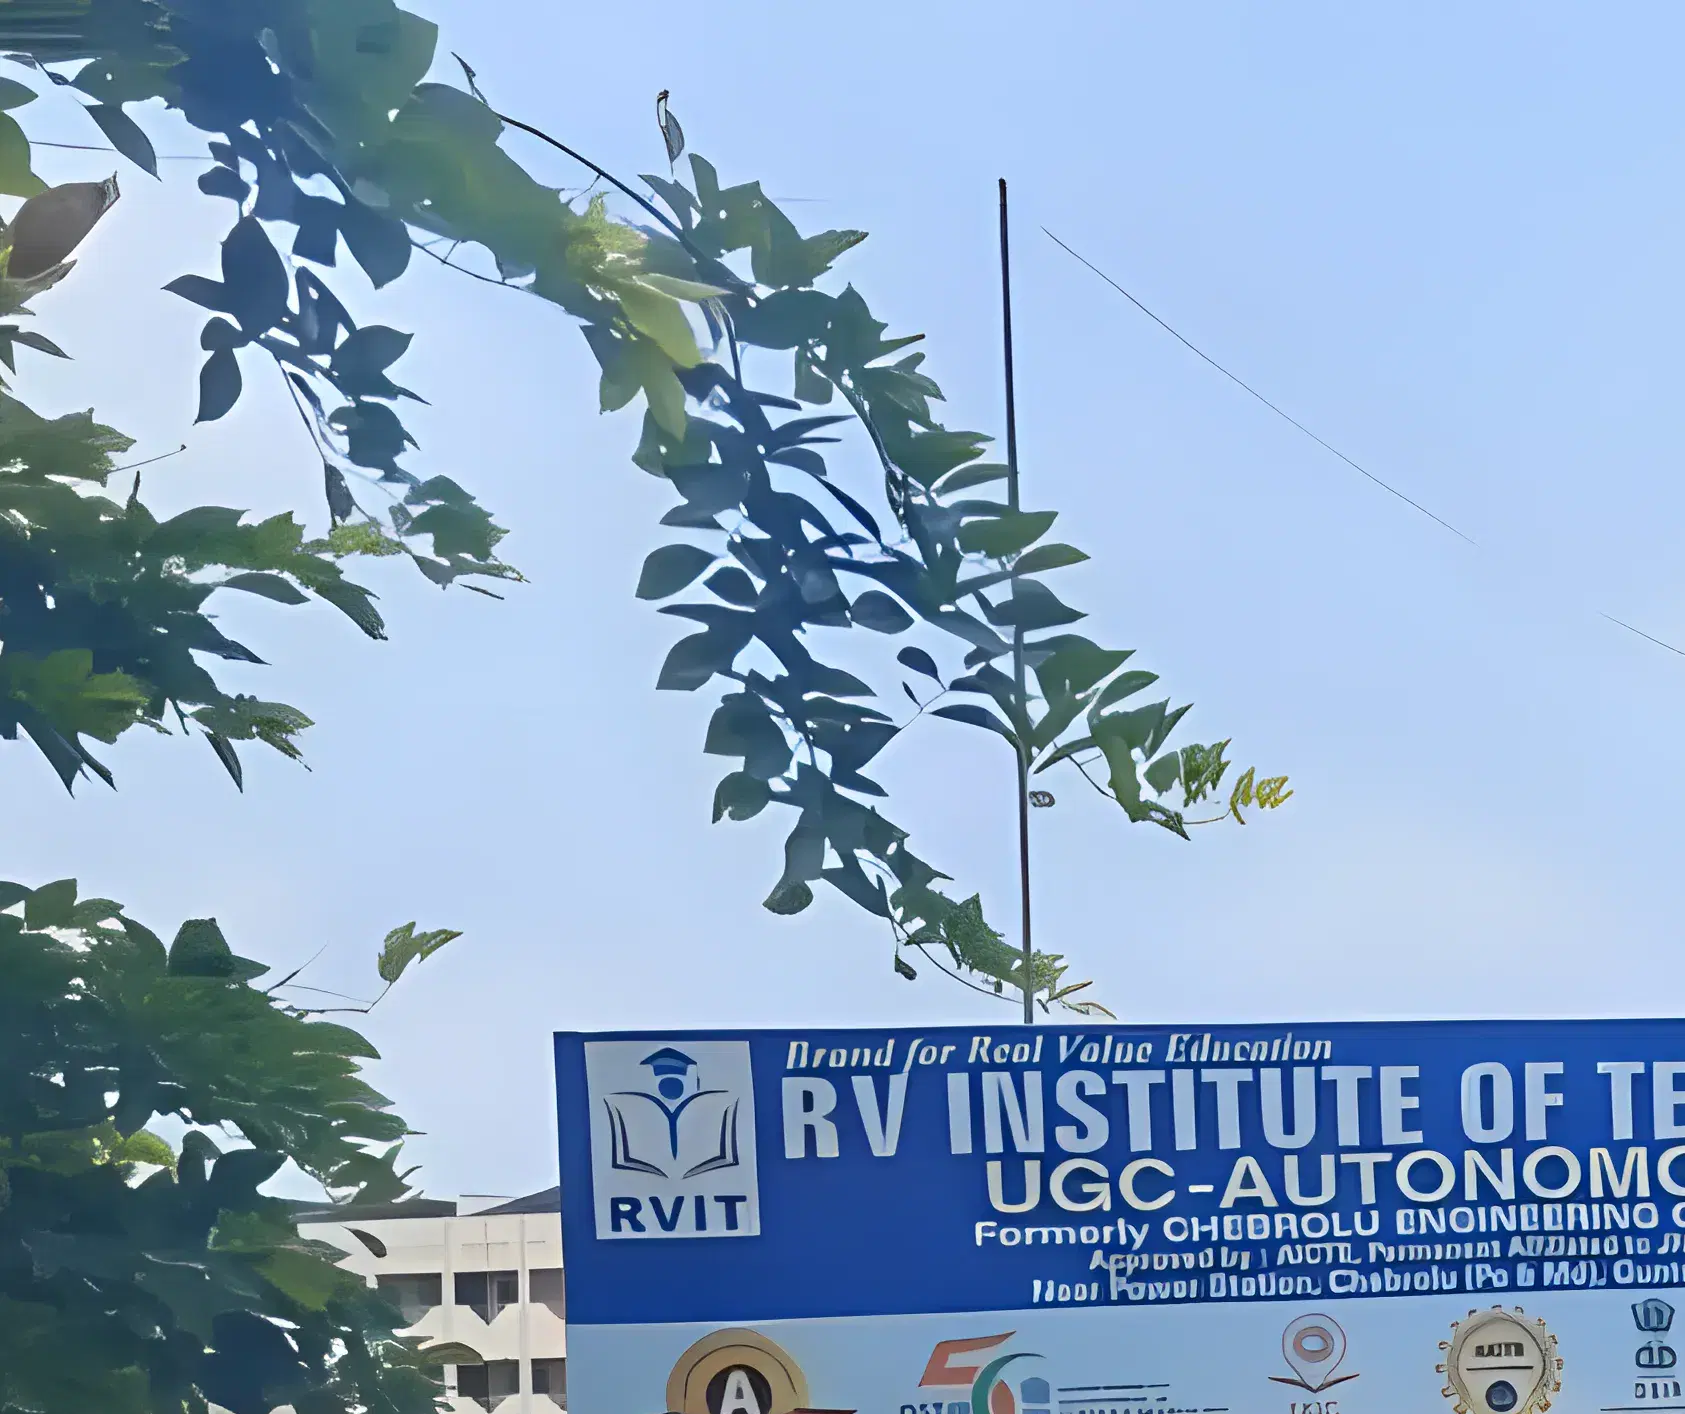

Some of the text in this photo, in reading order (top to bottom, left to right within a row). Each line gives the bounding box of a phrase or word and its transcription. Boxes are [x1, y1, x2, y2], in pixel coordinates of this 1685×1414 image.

[782, 1073, 912, 1159] RV
[948, 1065, 1424, 1157] INSTITUTE
[1461, 1062, 1565, 1144] OF
[610, 1194, 748, 1234] RVIT
